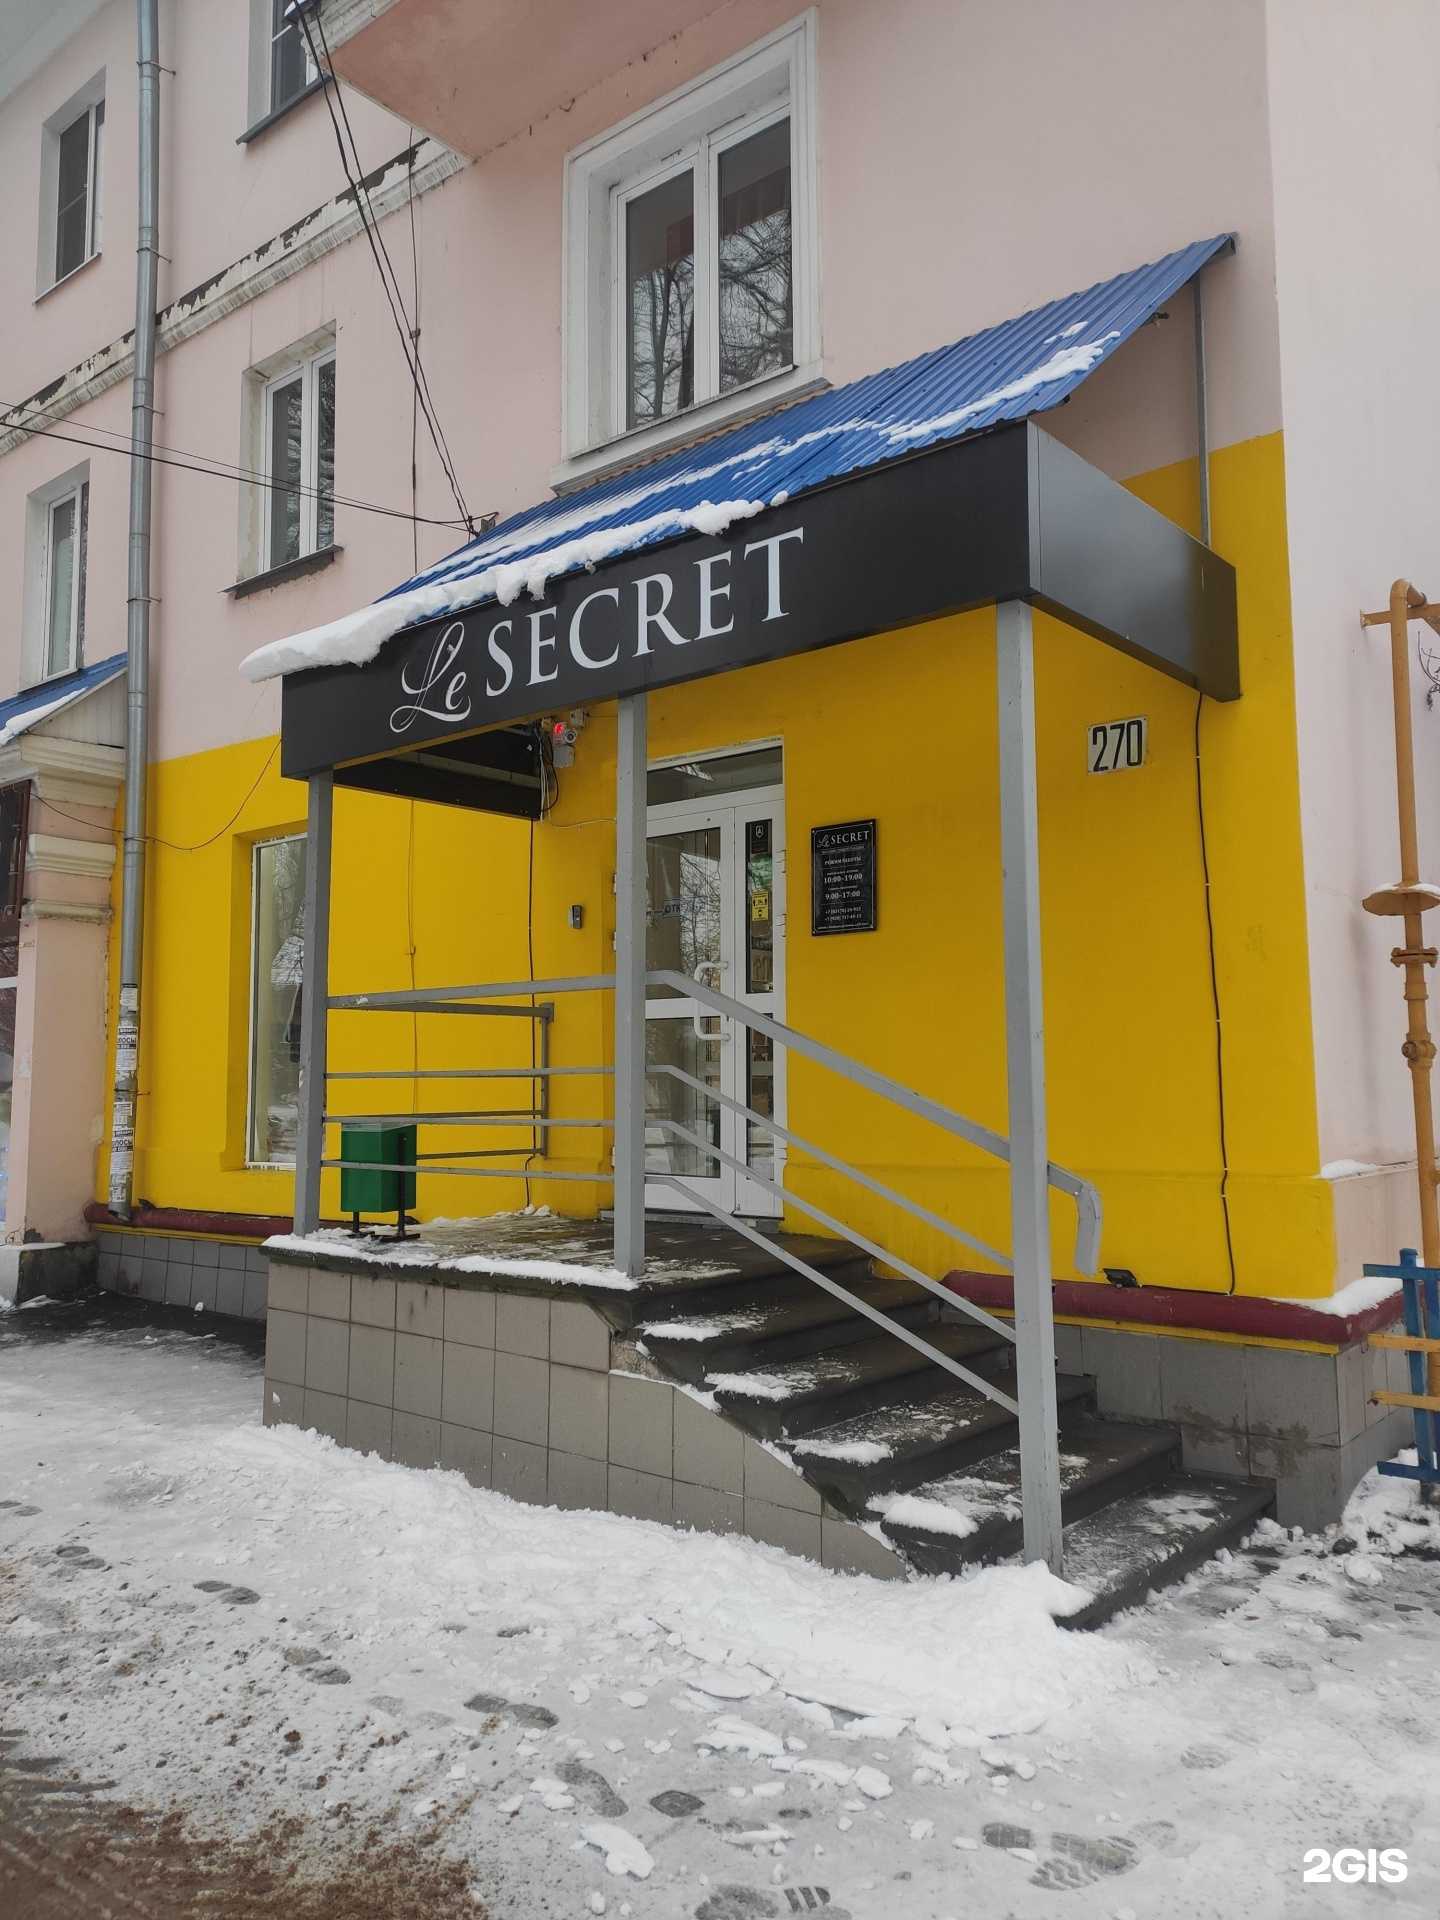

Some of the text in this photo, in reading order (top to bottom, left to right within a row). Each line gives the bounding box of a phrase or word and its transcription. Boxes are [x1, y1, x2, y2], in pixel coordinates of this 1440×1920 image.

[389, 527, 805, 733] Le SECRET
[1092, 719, 1143, 772] 270
[831, 830, 870, 845] SECRET
